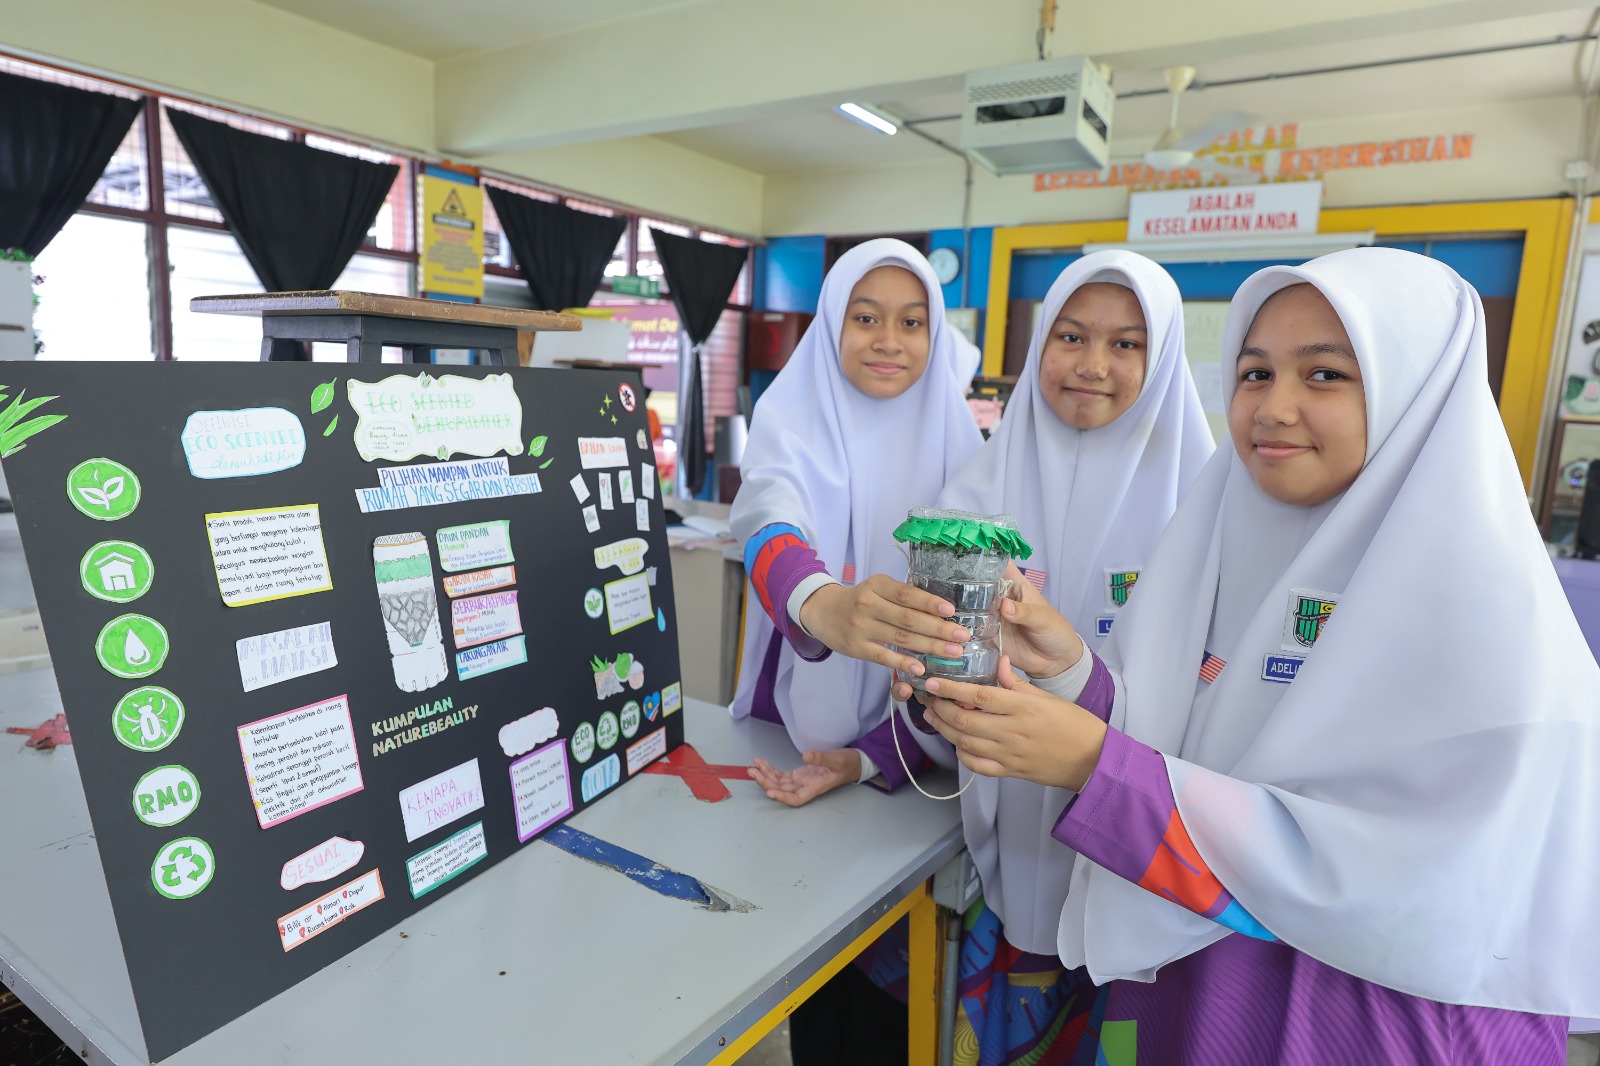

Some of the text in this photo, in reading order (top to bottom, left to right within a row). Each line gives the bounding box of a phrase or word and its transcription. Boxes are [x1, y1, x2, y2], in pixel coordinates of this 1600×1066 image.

[1278, 133, 1475, 176] KEBERSIHAN
[1186, 192, 1256, 212] JAGALAH
[1143, 211, 1298, 236] KESELAMATAN ANDA
[182, 434, 218, 455] ECO
[381, 460, 508, 487] PILIHAN MAMPAN UNTUK
[362, 475, 539, 513] RUMAH YANG SEGAR DAN BERSIH
[214, 536, 230, 547] yang
[231, 530, 260, 542] berfungsi
[459, 526, 490, 541] PANDAN
[213, 549, 231, 558] udara
[245, 585, 252, 593] di
[254, 582, 274, 592] dalam
[296, 573, 323, 584] tertutup
[257, 570, 271, 580] bagi
[239, 622, 331, 660] MASALAH
[458, 640, 509, 664] TAKUNGAN AIR
[260, 644, 329, 680] DIATASI
[1270, 661, 1302, 675] ADELI
[316, 707, 323, 715] di
[371, 696, 454, 737] KUMPULAN
[252, 746, 277, 759] Masalah
[330, 723, 345, 735] pada
[253, 733, 280, 747] tertutup
[372, 704, 479, 757] NATUREBEAUTY
[574, 725, 590, 746] ECO
[300, 747, 311, 755] dan
[255, 768, 285, 783] Kehadiran
[286, 757, 313, 772] serangga
[260, 796, 274, 806] Kos
[276, 785, 296, 799] tinggi
[296, 782, 308, 791] dan
[406, 778, 458, 815] KENAPA
[263, 801, 286, 815] elektrik
[289, 796, 302, 805] dari
[285, 842, 342, 887] SESUAI
[343, 902, 357, 913] Rak
